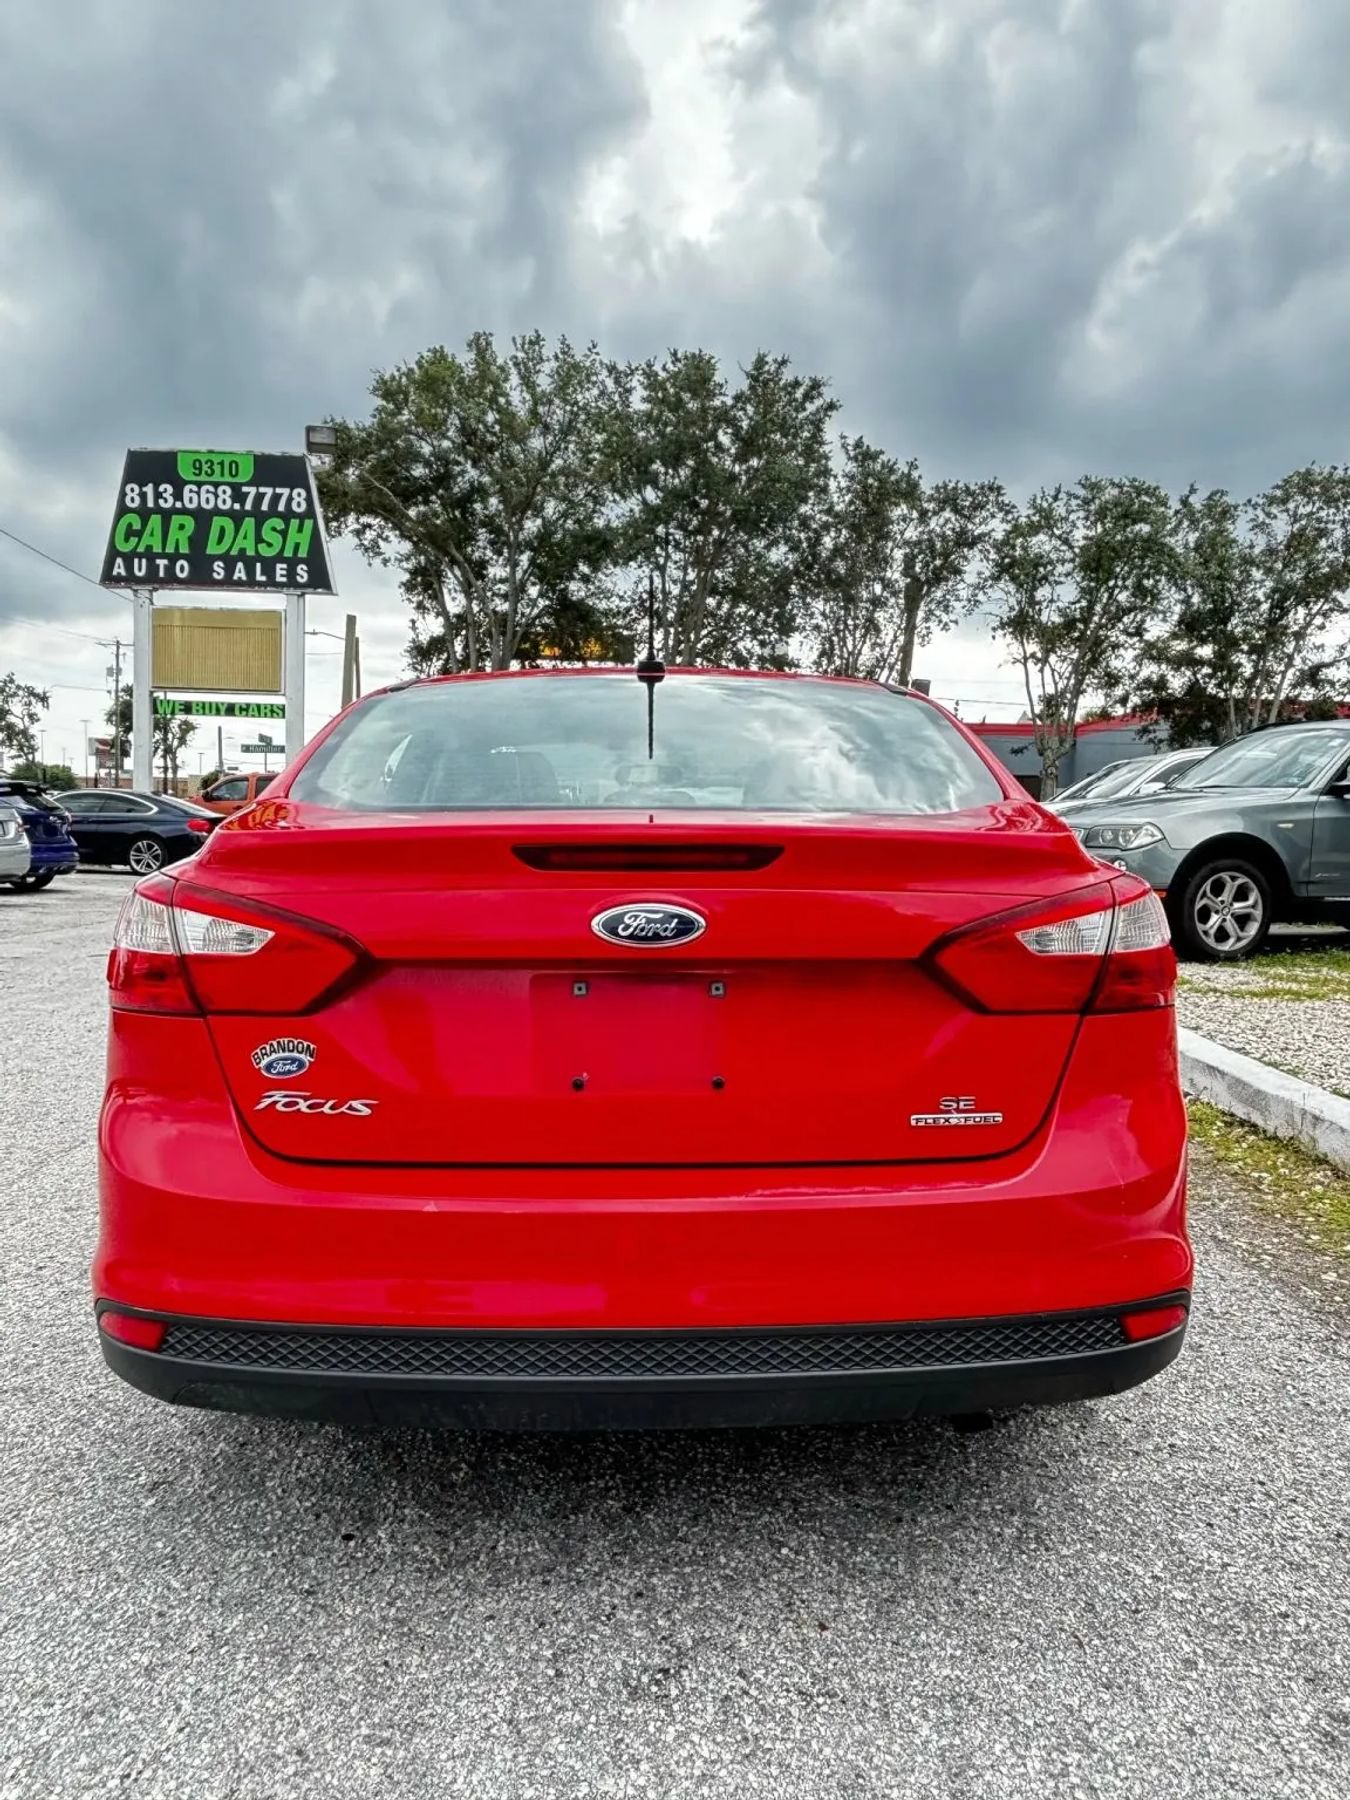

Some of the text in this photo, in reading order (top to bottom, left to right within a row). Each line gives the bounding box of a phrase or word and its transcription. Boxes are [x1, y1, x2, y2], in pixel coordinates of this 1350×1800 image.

[191, 458, 240, 479] 9310
[124, 482, 308, 514] 813.668.7778
[114, 512, 314, 559] CAR DASH
[112, 556, 309, 584] AUTO SALES
[156, 698, 284, 718] WE BUY CARS
[617, 911, 679, 937] Ford
[251, 1039, 316, 1067] BRANDON
[270, 1060, 299, 1074] Ford
[939, 1096, 976, 1110] SE
[912, 1115, 1002, 1125] FLEX FUEL
